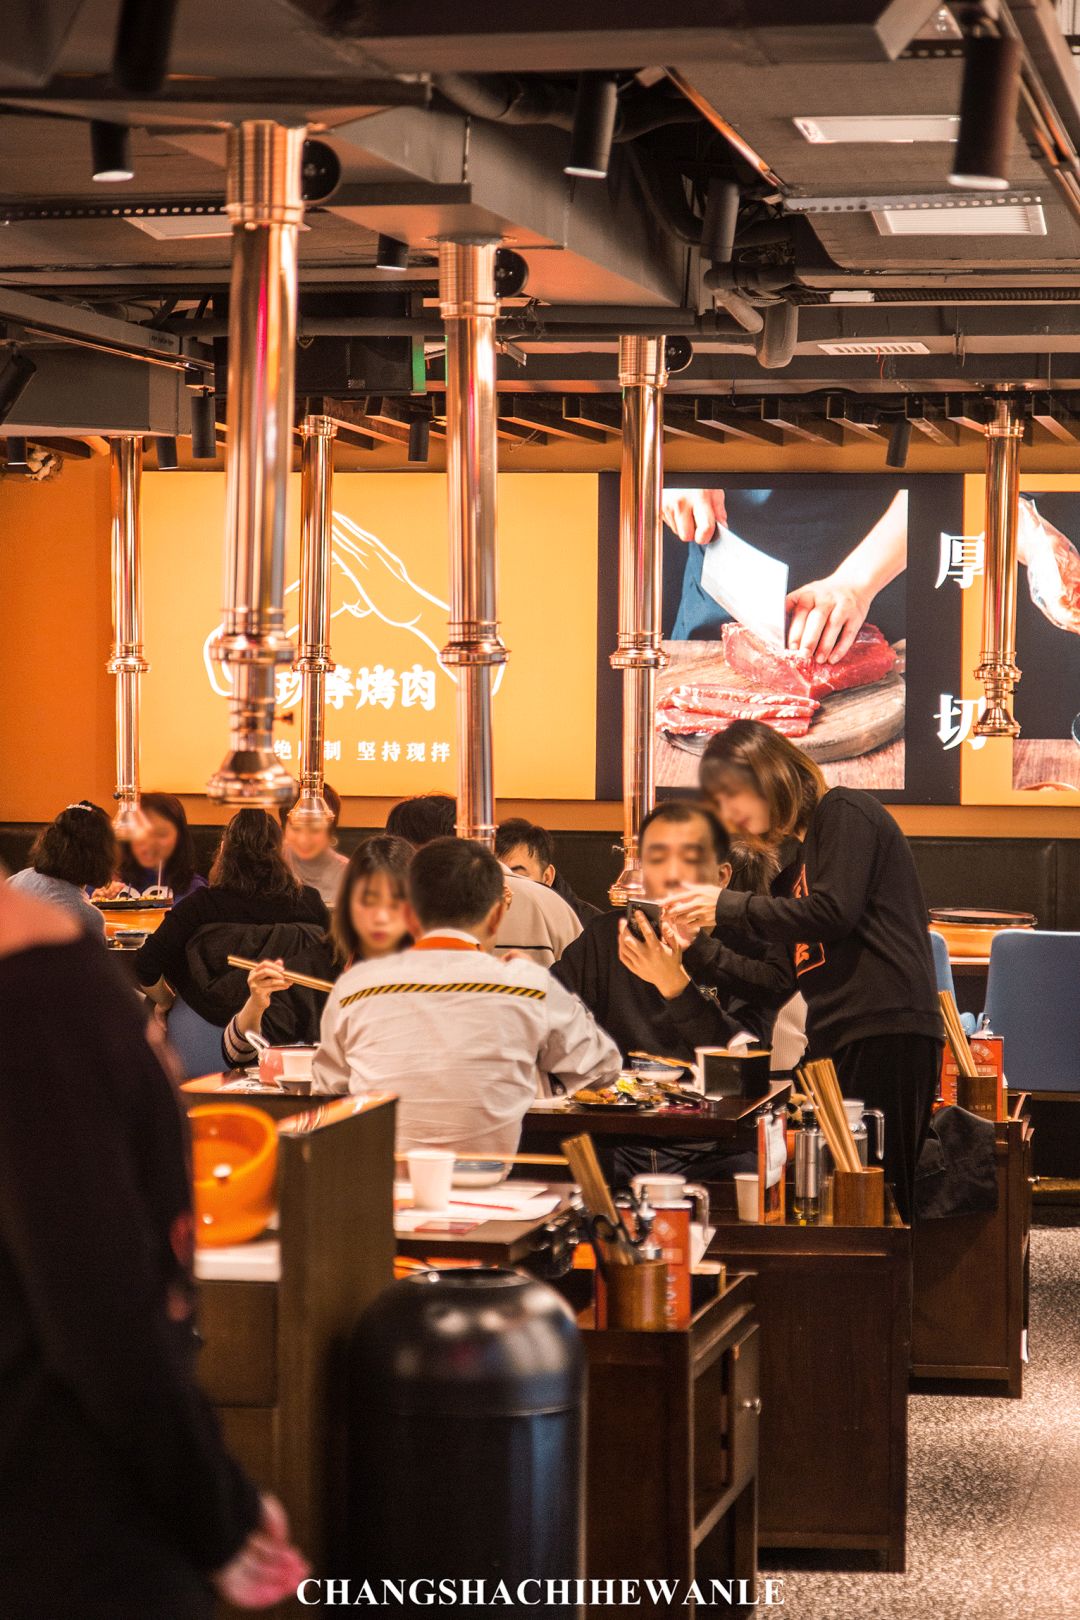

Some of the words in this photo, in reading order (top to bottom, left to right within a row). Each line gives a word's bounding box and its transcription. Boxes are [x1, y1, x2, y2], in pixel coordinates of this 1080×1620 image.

[274, 740, 341, 760] 绝制
[357, 741, 450, 762] 坚持现拌
